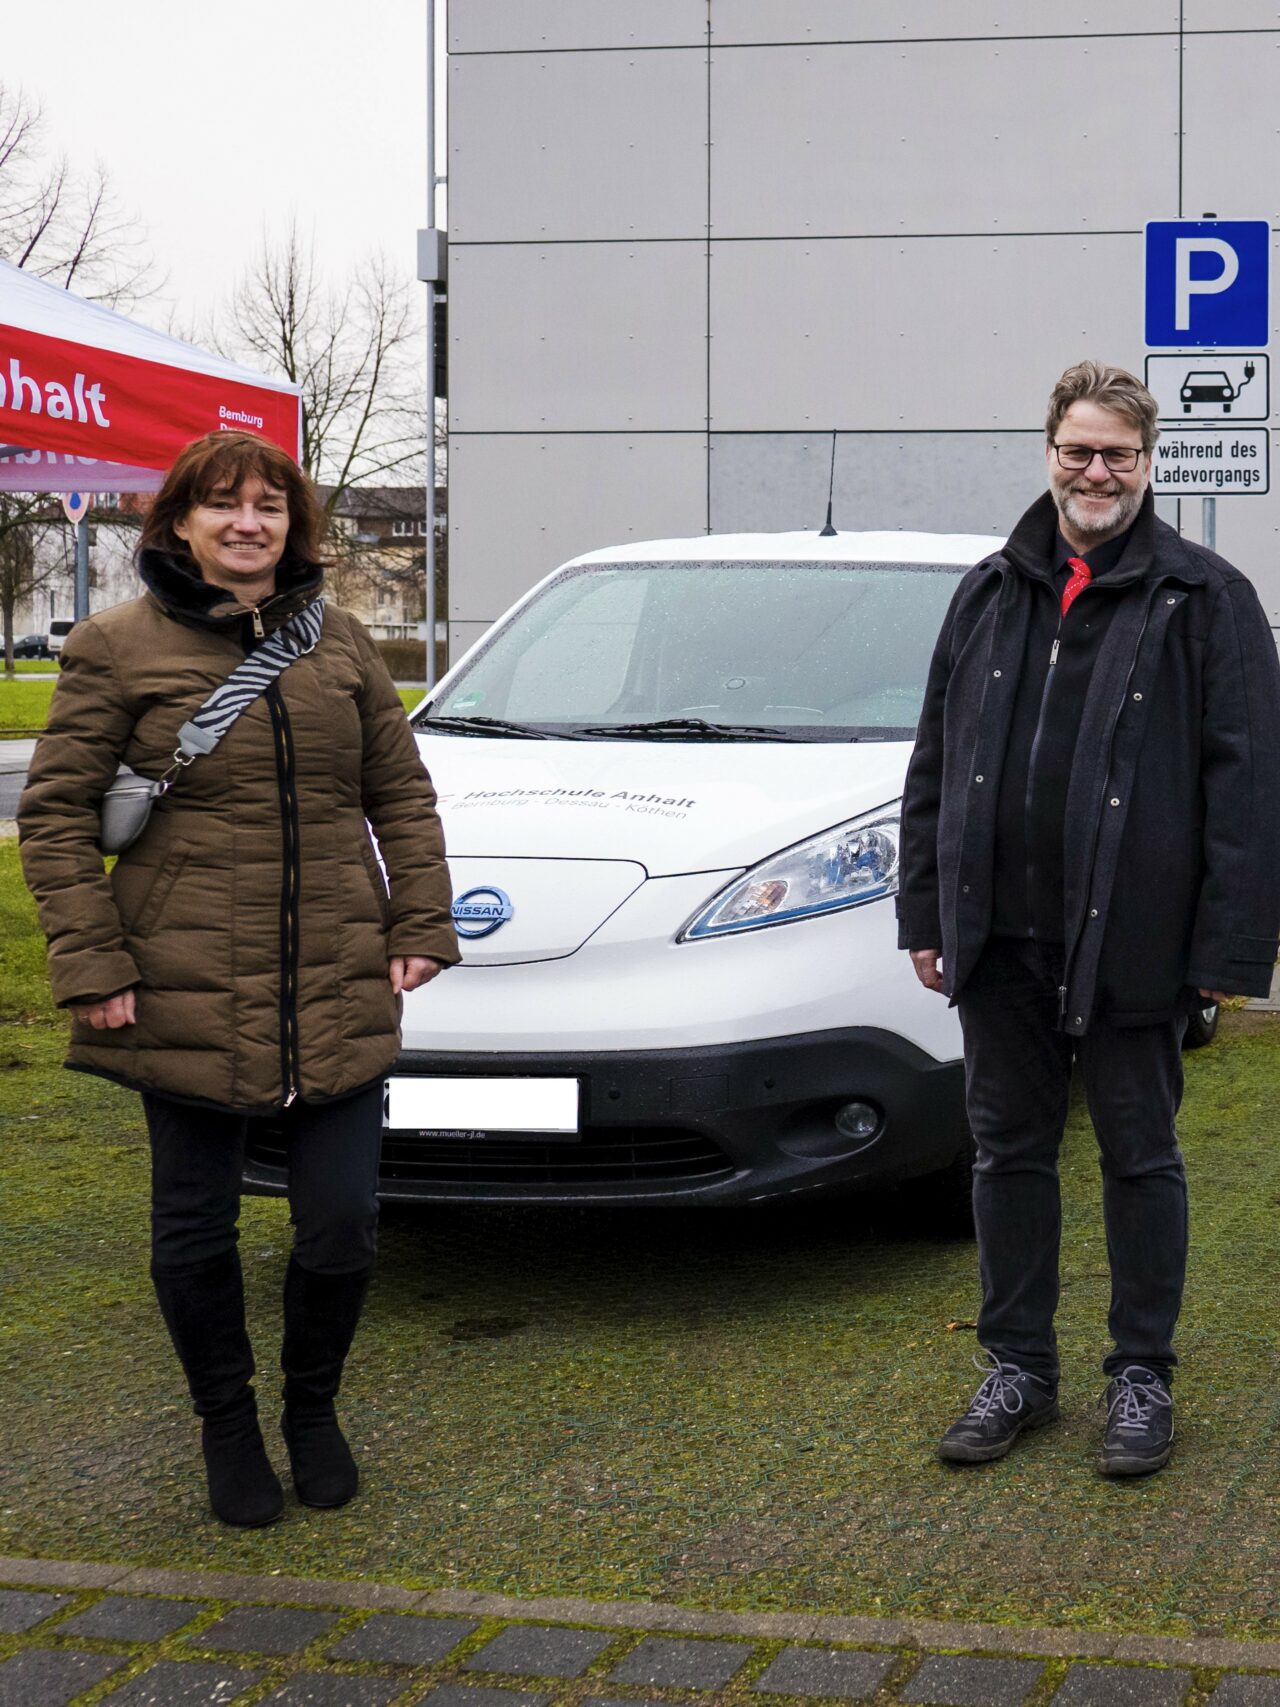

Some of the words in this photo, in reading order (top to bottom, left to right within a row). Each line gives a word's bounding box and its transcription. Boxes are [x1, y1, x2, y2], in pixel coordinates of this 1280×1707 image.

[1175, 237, 1239, 331] P
[219, 405, 263, 428] Bernburg
[1158, 440, 1222, 459] während
[1231, 440, 1257, 458] des
[1155, 465, 1260, 487] Ladevorgangs
[464, 788, 606, 800] Hochschule
[610, 791, 697, 809] Anhalt
[544, 797, 609, 809] Dessau
[451, 906, 505, 916] NISSAN
